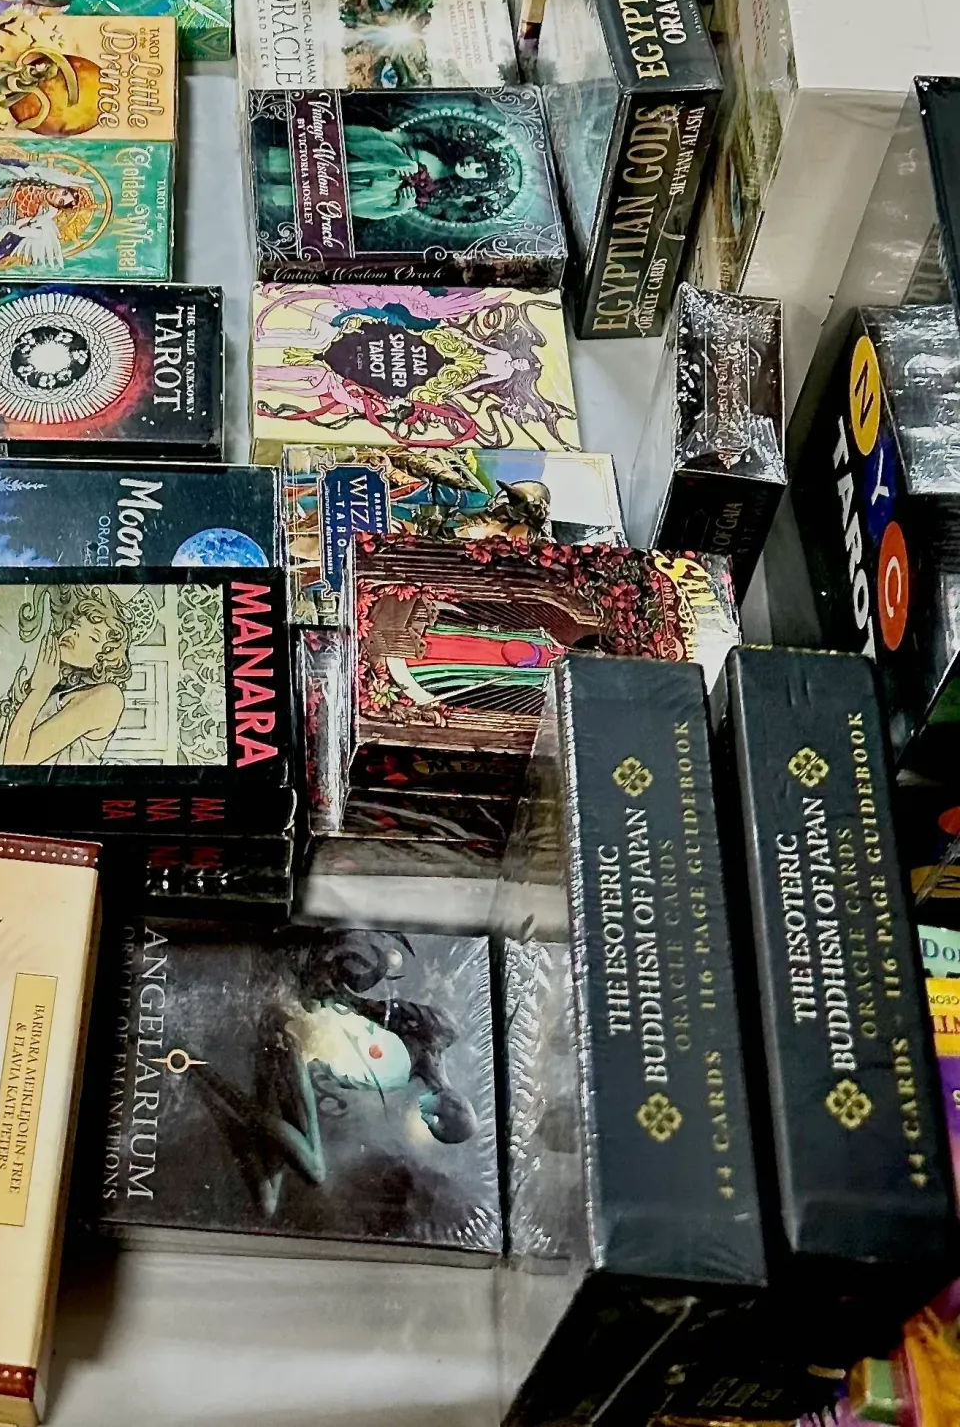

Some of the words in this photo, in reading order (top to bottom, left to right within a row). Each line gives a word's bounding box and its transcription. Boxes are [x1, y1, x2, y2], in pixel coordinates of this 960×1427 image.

[149, 27, 160, 60] TAROT
[304, 37, 318, 85] SHAMAN
[97, 22, 139, 129] Prince
[127, 55, 165, 129] Little
[295, 117, 305, 130] BY
[308, 91, 334, 143] Vintage
[297, 131, 310, 180] VICTORIA
[313, 141, 338, 198] Wisdom
[670, 146, 695, 196] SILVANA
[156, 179, 167, 213] TAROT
[301, 181, 314, 226] MOSELEY
[315, 199, 345, 251] Oracle
[591, 192, 657, 333] EGYPTIAN
[624, 104, 679, 184] GODS
[113, 203, 154, 272] Wheel
[648, 257, 667, 292] CARDS
[186, 304, 197, 327] THE
[640, 290, 661, 331] ORACLE
[152, 305, 185, 413] TAROT
[185, 329, 196, 357] WILD
[367, 339, 387, 380] TAROT
[389, 333, 408, 389] SPINNER
[410, 344, 428, 377] STAR
[185, 360, 197, 415] UNKNOWN
[115, 477, 163, 568] Moon
[833, 415, 878, 664] TAROT
[230, 580, 280, 769] MANARA
[102, 799, 137, 821] RA
[146, 797, 181, 823] NA
[190, 796, 225, 824] MA
[673, 719, 706, 876] GUIDEBOOK
[847, 710, 884, 866] GUIDEBOOK
[625, 806, 655, 885] JAPAN
[802, 795, 833, 878] JAPAN
[657, 838, 681, 927] CARDS
[813, 878, 838, 917] OF
[837, 827, 863, 916] CARDS
[597, 843, 628, 977] ESOTERIC
[629, 886, 656, 926] OF
[775, 832, 812, 974] ESOTERIC
[690, 885, 719, 1010] 116-PAGE
[870, 872, 901, 999] 116-PAGE
[607, 977, 632, 1037] THE
[634, 929, 668, 1084] BUDDHISM
[666, 938, 693, 1051] ORACLE
[792, 972, 818, 1024] THE
[818, 917, 857, 1073] BUDDHISM
[849, 925, 879, 1040] ORACLE
[17, 1020, 28, 1032] &
[28, 1002, 46, 1059] BARBARA
[8, 1033, 26, 1080] FLAVIA
[126, 925, 169, 1202] ANGELARIUM
[3, 1083, 18, 1120] KATE
[705, 1049, 730, 1151] CARDS
[891, 1037, 921, 1140] CARDS
[7, 1059, 38, 1195] MEIKLEJOHN-FREE
[102, 1055, 130, 1202] EMANATIONS
